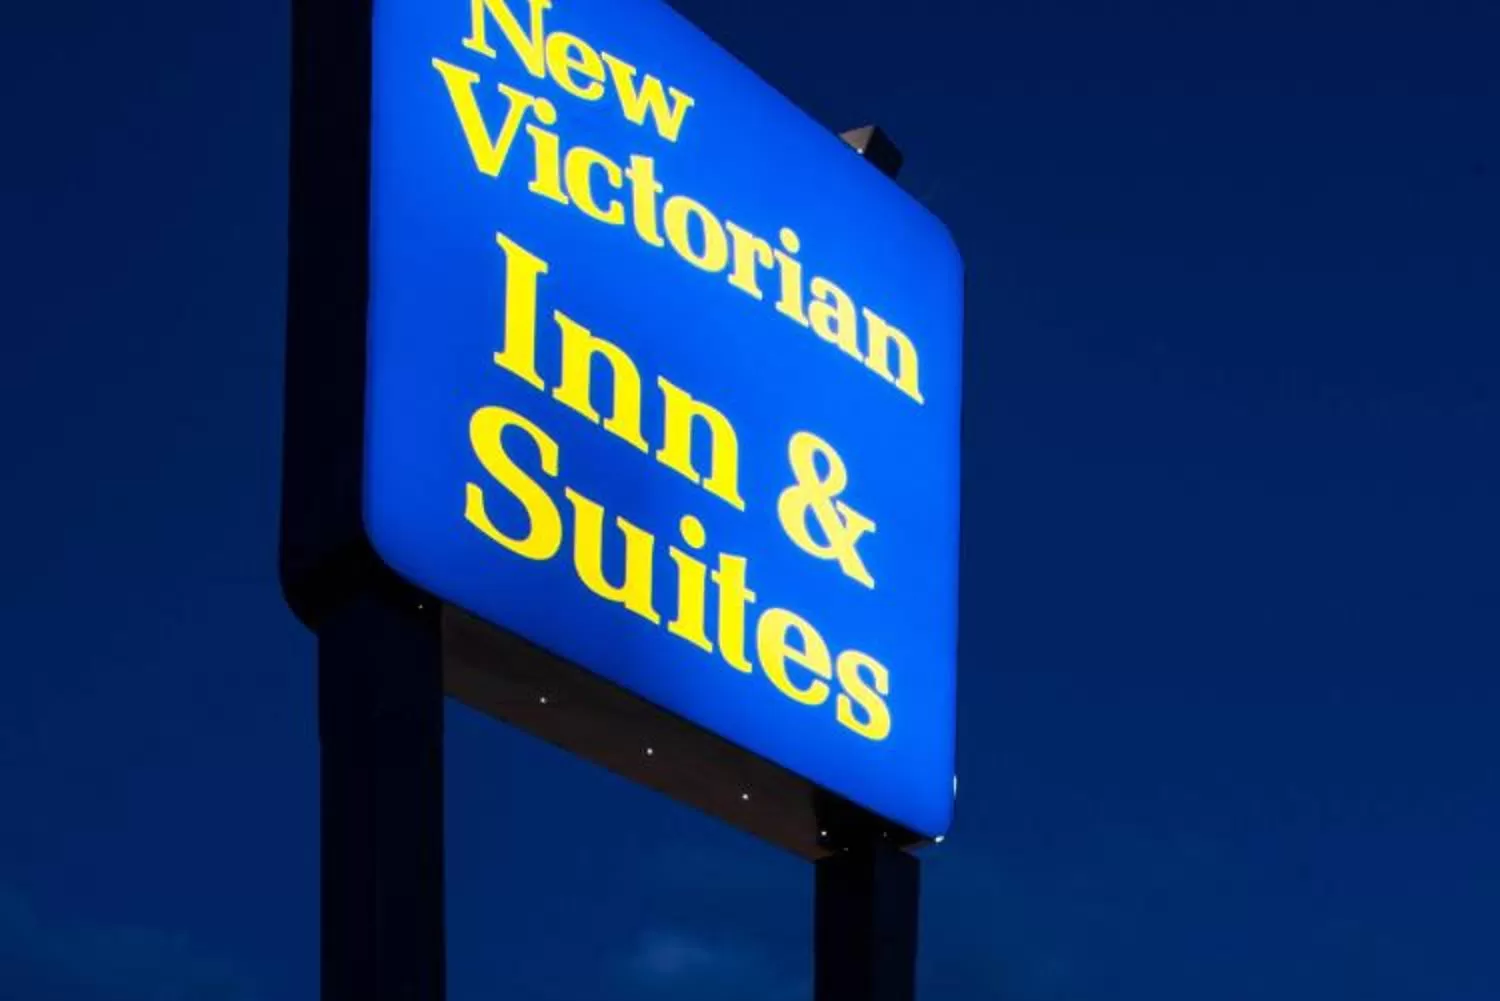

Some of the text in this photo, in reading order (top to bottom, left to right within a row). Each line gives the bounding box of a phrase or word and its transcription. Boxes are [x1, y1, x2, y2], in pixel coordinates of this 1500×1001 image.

[433, 58, 924, 404] Victorian
[462, 0, 695, 142] New
[464, 407, 891, 740] Suites
[493, 233, 876, 589] Inn &
